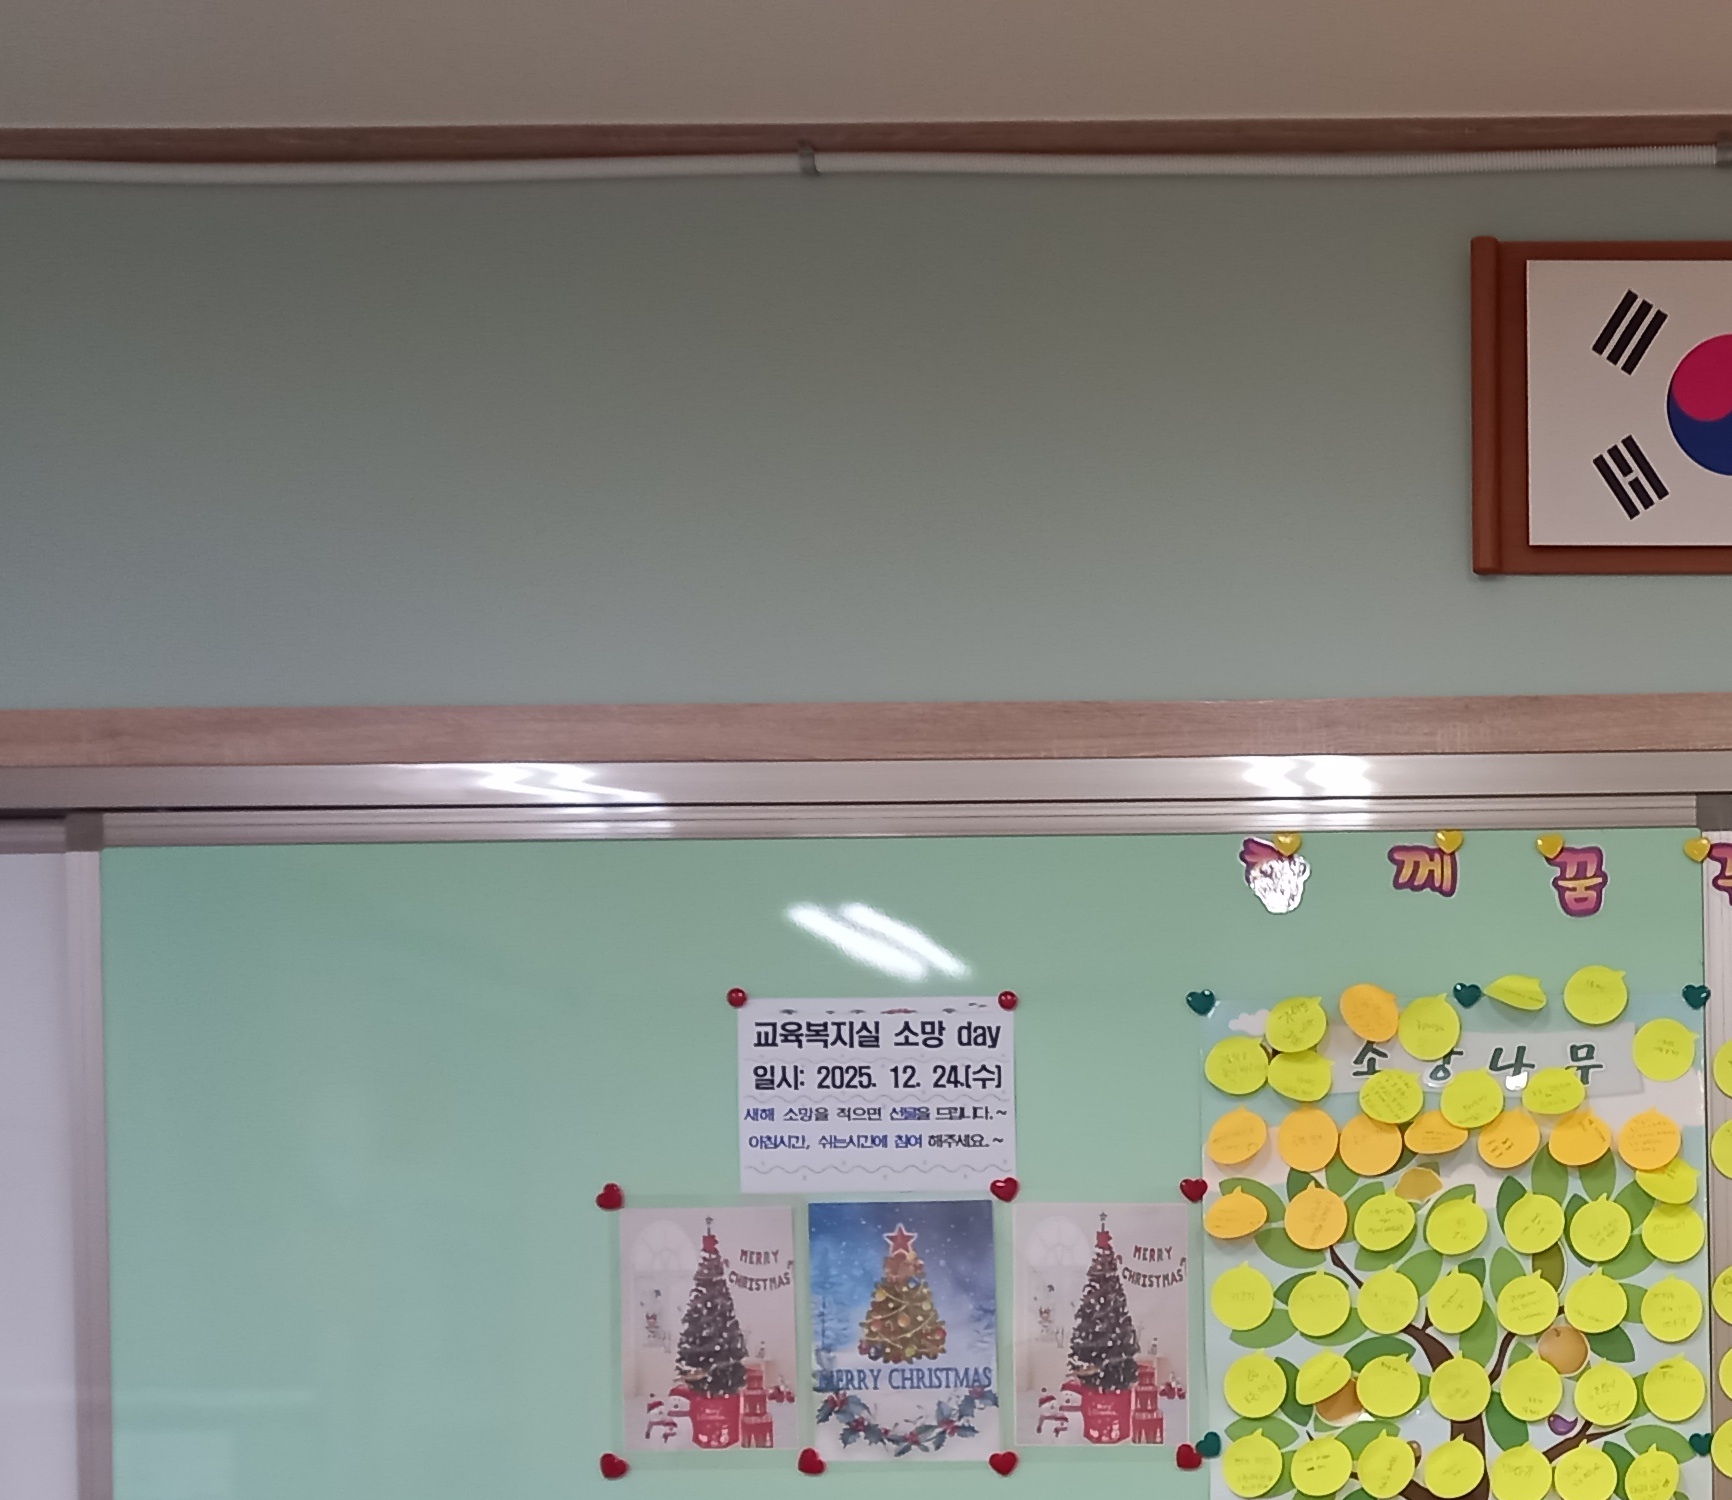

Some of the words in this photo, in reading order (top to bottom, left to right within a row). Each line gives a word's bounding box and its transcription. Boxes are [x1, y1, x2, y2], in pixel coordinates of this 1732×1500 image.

[753, 1020, 881, 1049] 교육복지실
[893, 1020, 946, 1049] 소망
[957, 1021, 1002, 1049] day
[752, 1065, 805, 1090] 일시:
[816, 1065, 877, 1090] 2025.
[889, 1065, 921, 1089] 12.
[744, 1107, 775, 1122] 새해
[783, 1106, 829, 1122] 소망을
[836, 1106, 882, 1121] 적으면
[889, 1106, 931, 1121] 선물을
[740, 1249, 779, 1266] MERRY
[1133, 1244, 1173, 1263] MERRY
[728, 1270, 791, 1292] CHRISTMAS
[1121, 1266, 1184, 1288] CHRISTMAS
[888, 1366, 993, 1390] CHRISTMAS
